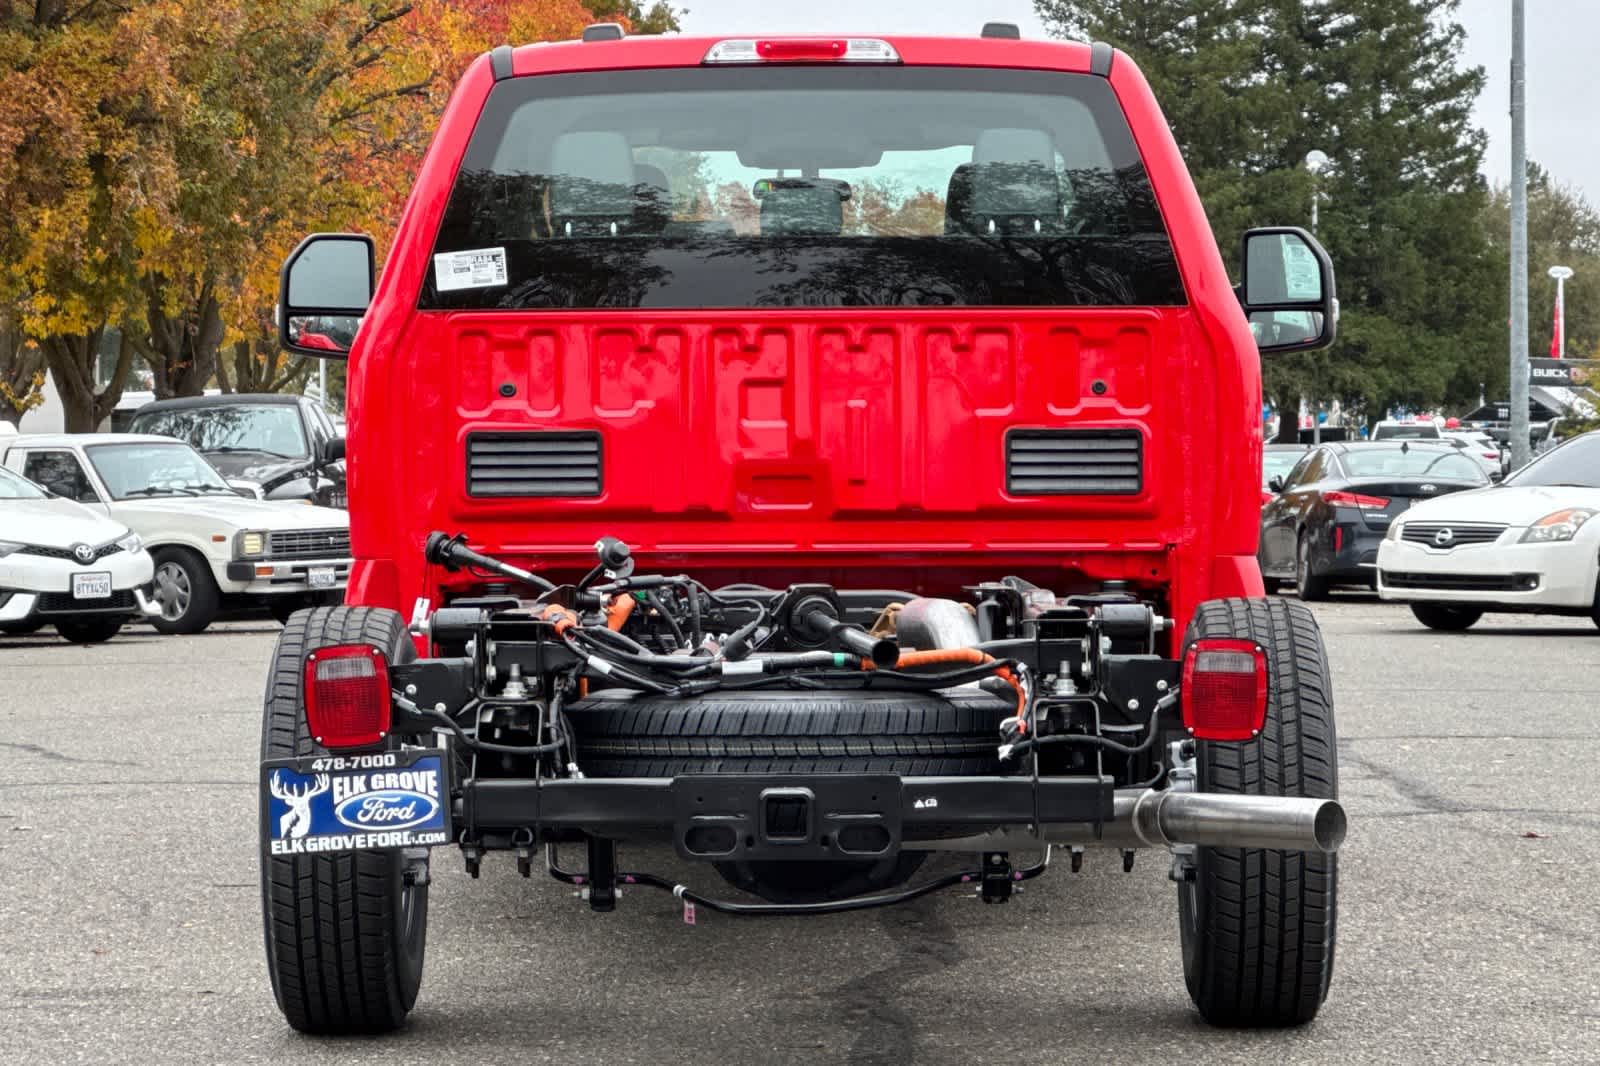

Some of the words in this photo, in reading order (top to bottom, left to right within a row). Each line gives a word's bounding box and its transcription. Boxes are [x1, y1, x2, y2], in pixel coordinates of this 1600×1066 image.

[1533, 368, 1569, 378] BUICK
[311, 753, 396, 772] 478-7000
[332, 774, 367, 805] ELK
[371, 770, 439, 798] GROVE
[357, 796, 416, 822] Ford
